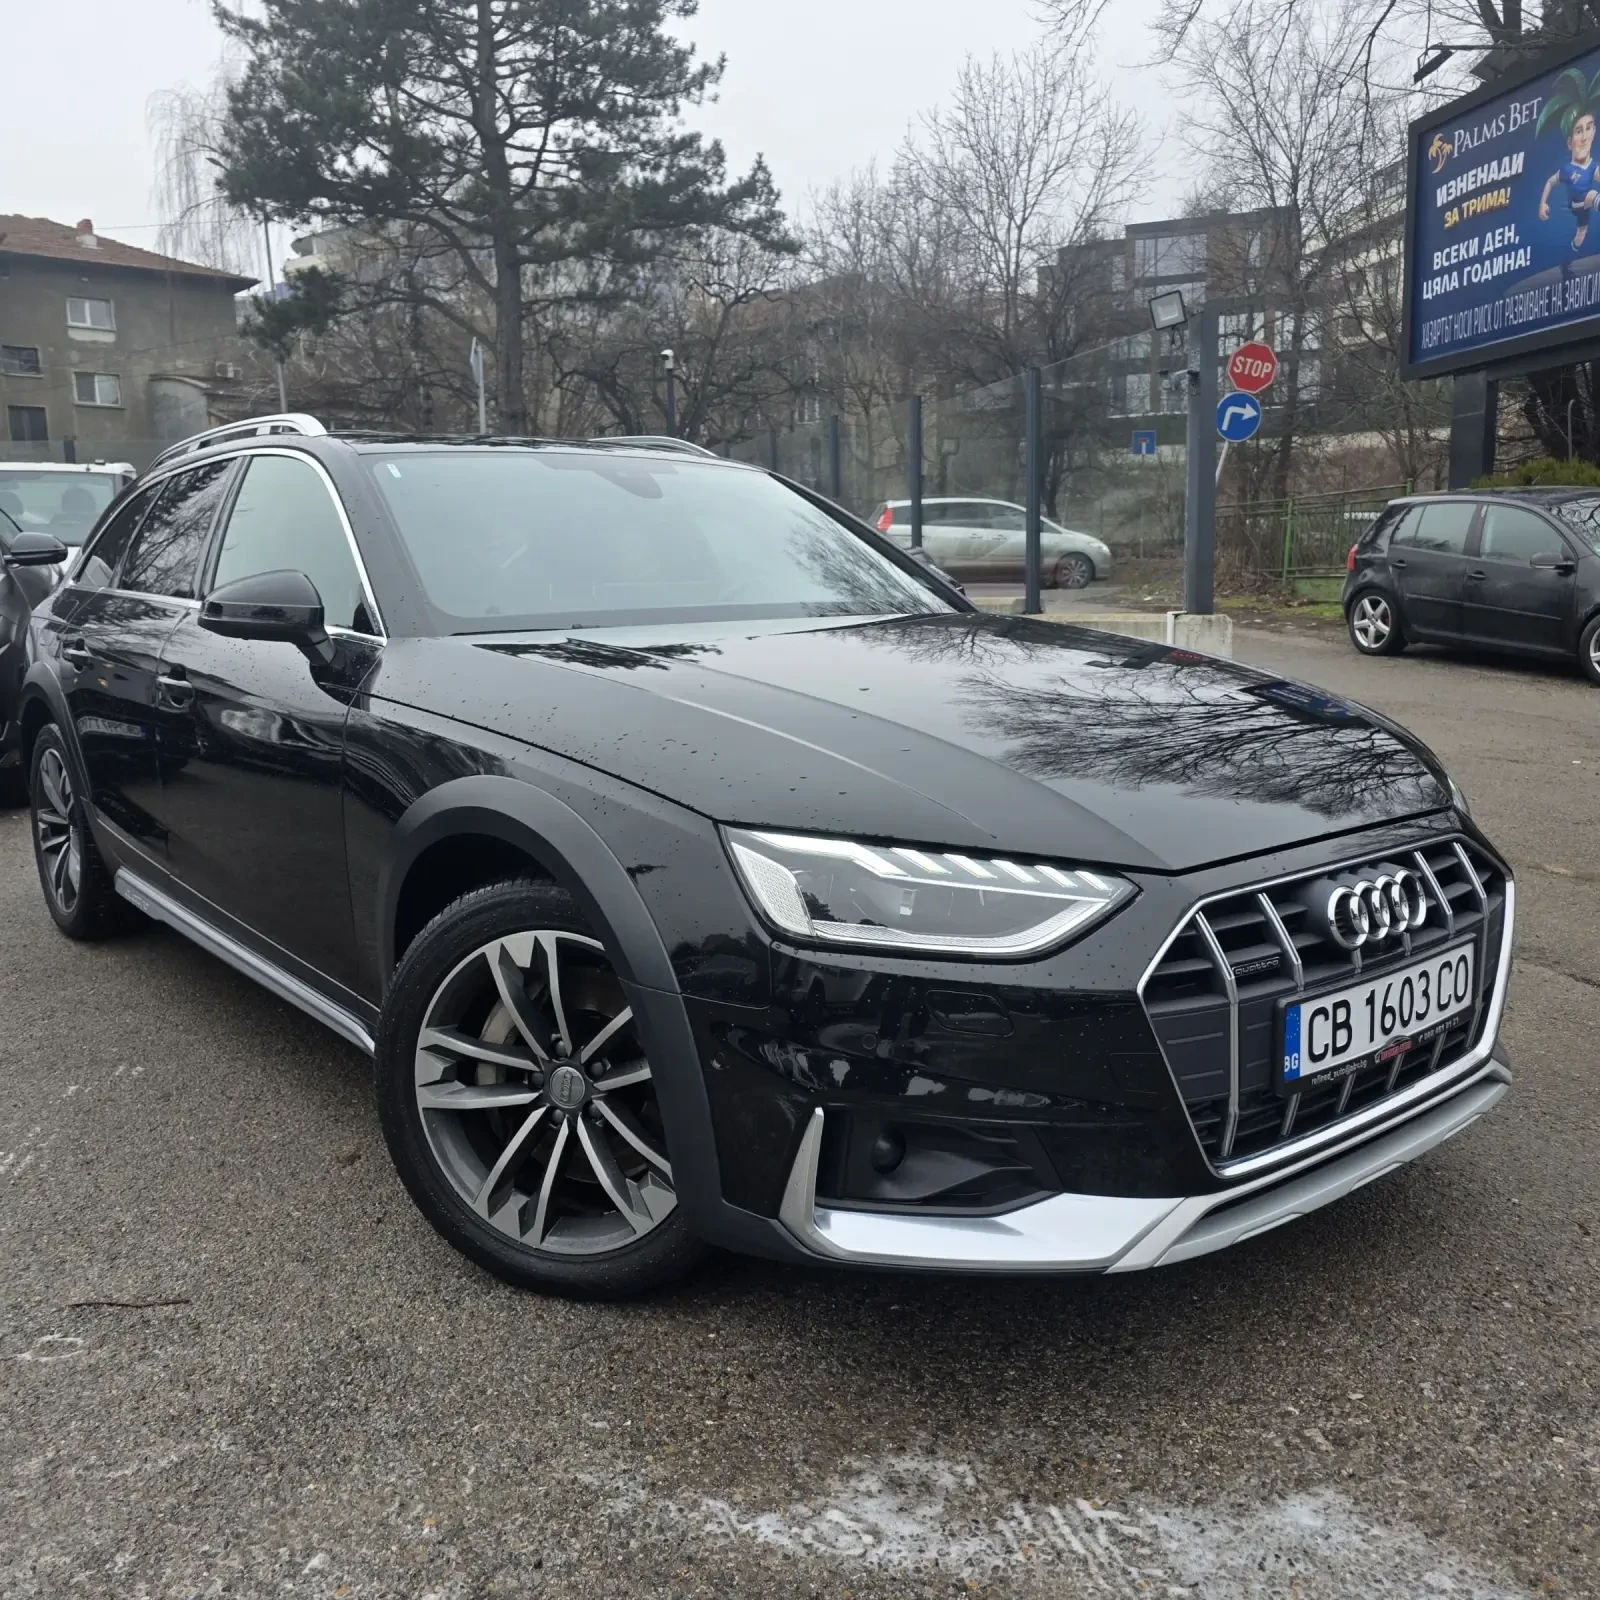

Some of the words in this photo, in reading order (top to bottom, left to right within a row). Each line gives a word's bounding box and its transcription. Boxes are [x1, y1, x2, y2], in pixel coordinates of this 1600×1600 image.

[1452, 114, 1506, 158] PALMS
[1508, 96, 1542, 133] BET
[1436, 151, 1525, 207] ИЗНЕНАДИ
[1444, 207, 1460, 229] ЗА
[1462, 186, 1511, 219] ТРИМА!
[1423, 271, 1460, 300] ЦЯЛА
[1463, 245, 1532, 287] ГОДИНА!
[1433, 236, 1479, 270] ВСЕКИ
[1482, 223, 1520, 256] ДЕН,
[1453, 307, 1473, 341] НОСИ
[1473, 302, 1493, 335] РИСК
[1493, 299, 1504, 330] ОТ
[1504, 286, 1550, 327] РАЗВИВАНЕ
[1551, 282, 1563, 316] НА
[1233, 355, 1273, 379] STOP
[1308, 999, 1353, 1063] CB
[1365, 969, 1431, 1043] 1603
[1437, 953, 1469, 1012] CO
[1284, 1052, 1299, 1073] BG
